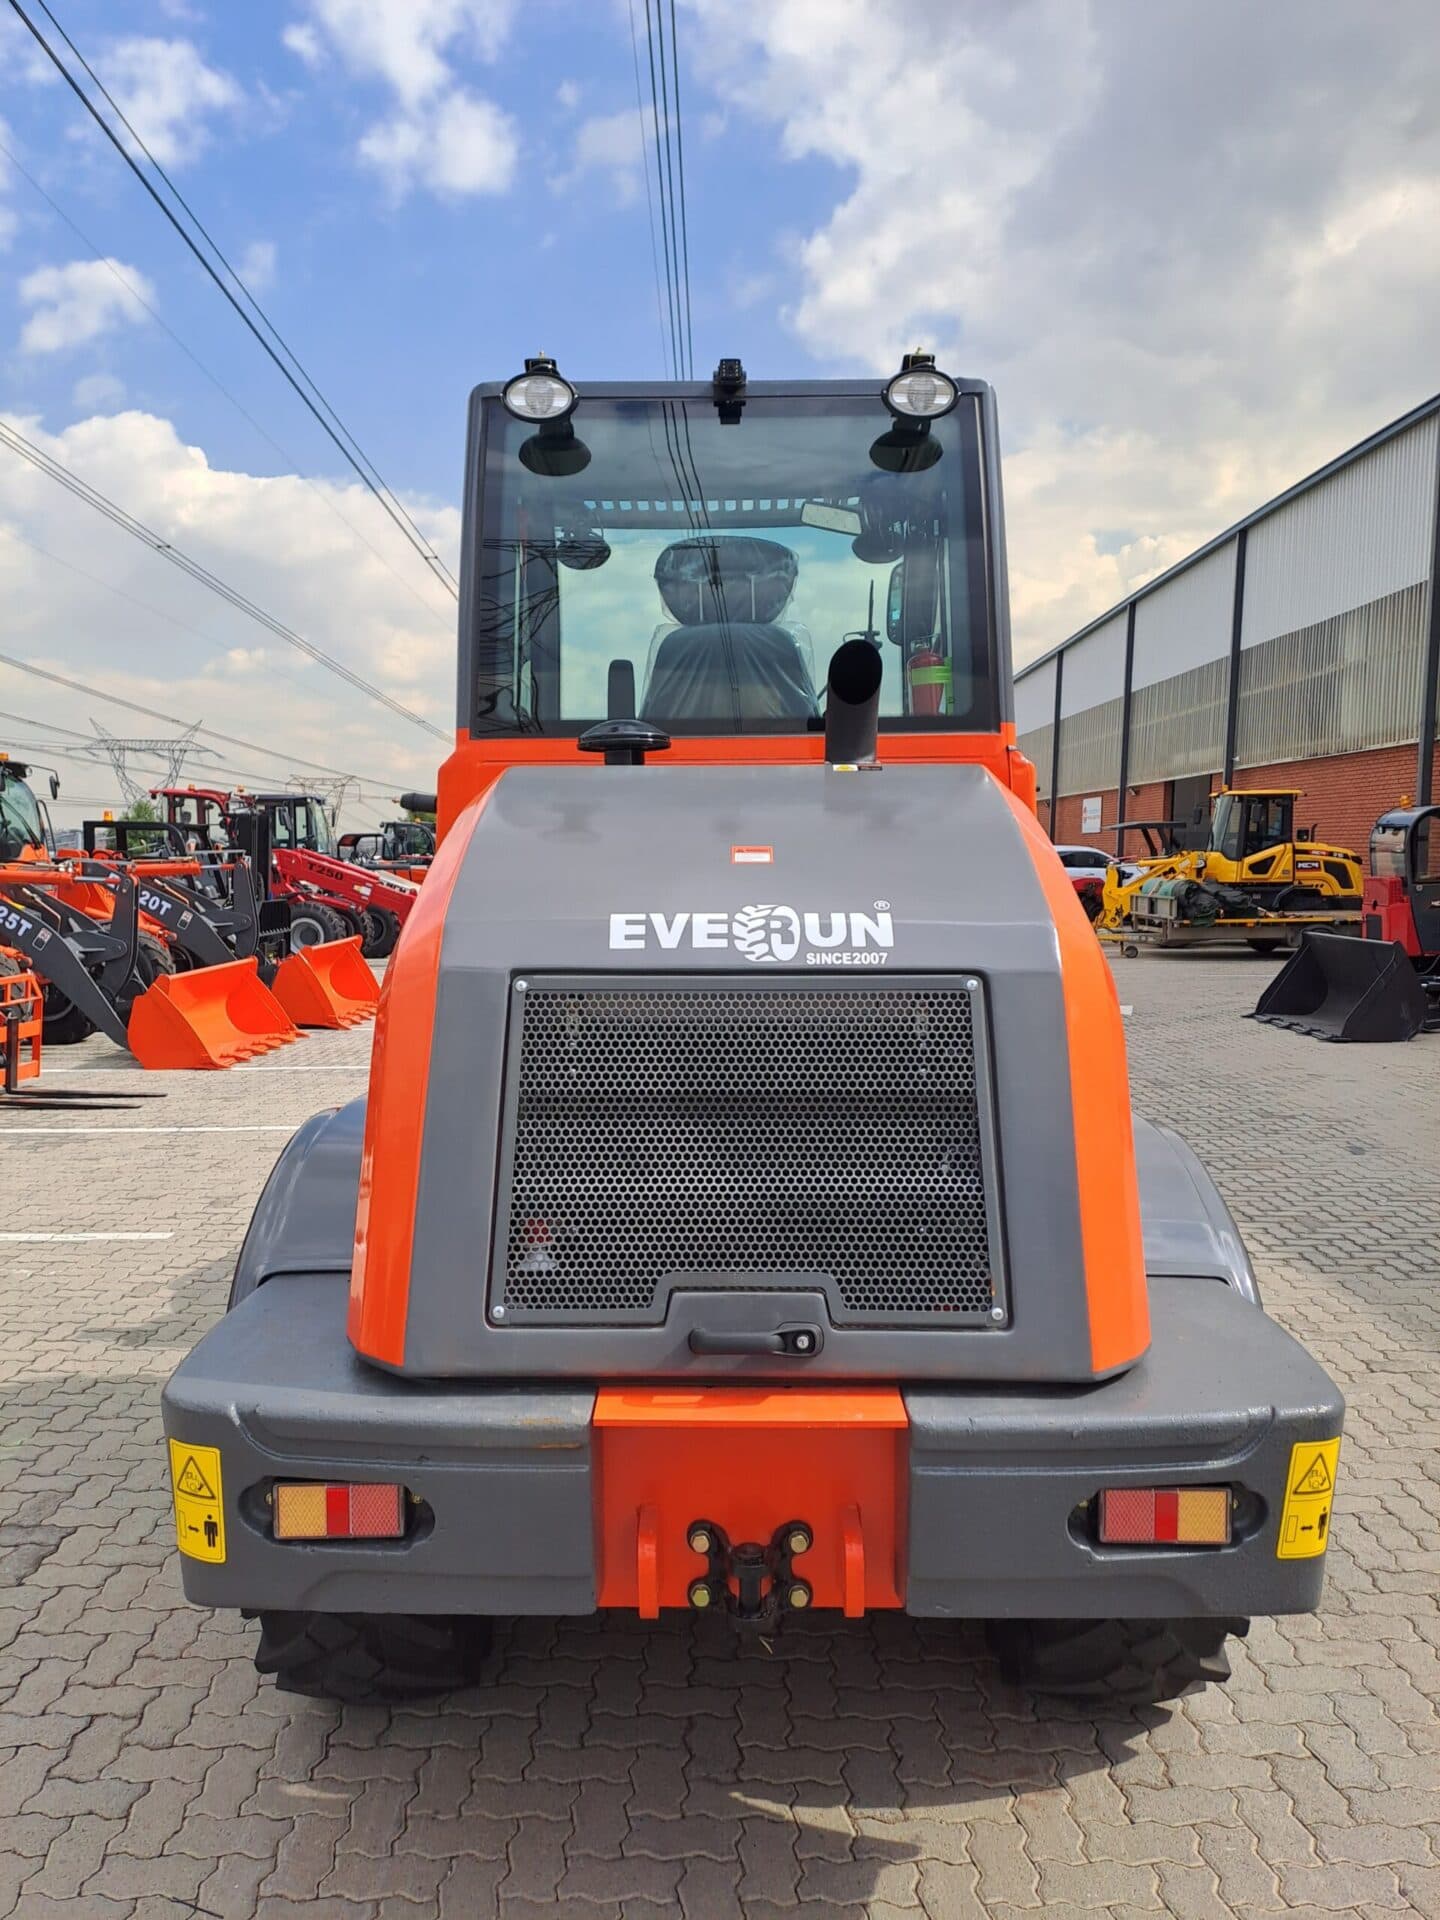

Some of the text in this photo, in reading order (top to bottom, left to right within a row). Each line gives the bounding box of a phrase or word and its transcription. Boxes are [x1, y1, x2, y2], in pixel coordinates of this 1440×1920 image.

[308, 863, 344, 881] T250
[138, 890, 172, 916] 20T
[608, 904, 895, 962] EVERUN
[806, 952, 888, 965] SINCE2007
